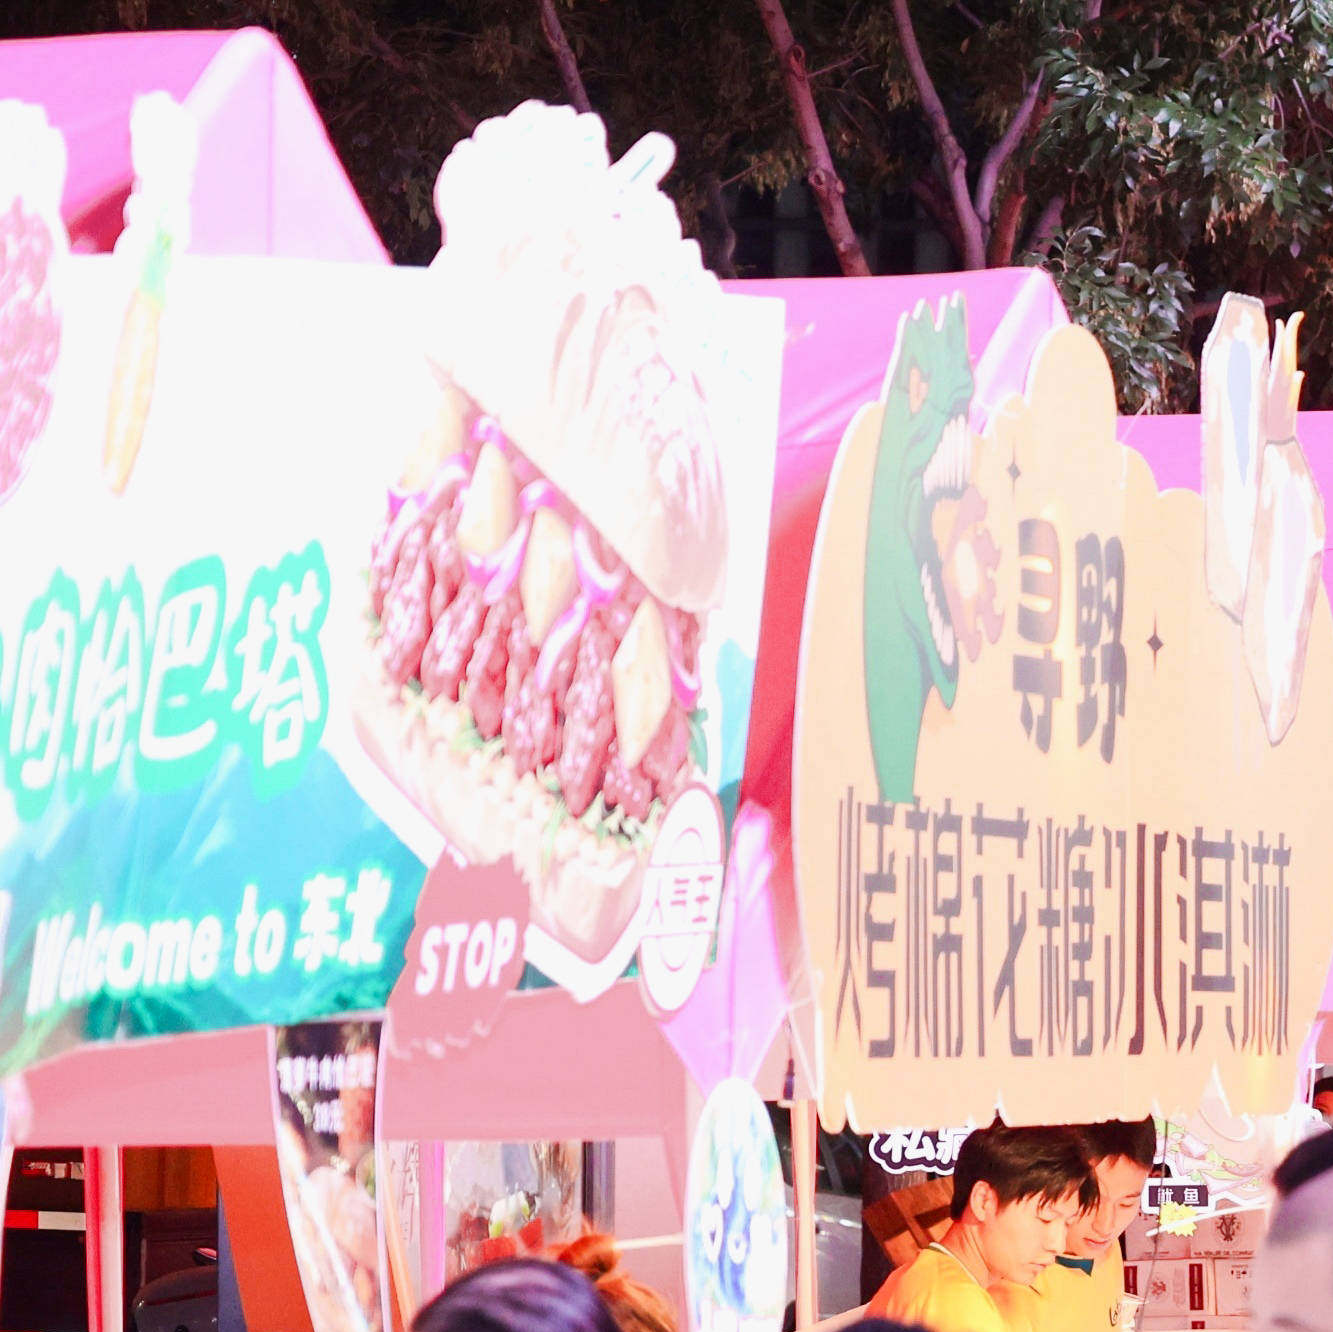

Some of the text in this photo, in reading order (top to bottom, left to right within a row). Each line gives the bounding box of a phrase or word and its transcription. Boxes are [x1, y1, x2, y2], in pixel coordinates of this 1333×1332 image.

[1011, 516, 1129, 766] 寻野
[26, 902, 223, 1017] Welcome
[233, 884, 286, 977] to
[415, 918, 517, 996] STOP
[833, 785, 1293, 1059] 烤棉花糖冰淇淋
[1157, 1187, 1200, 1205] 鱿鱼
